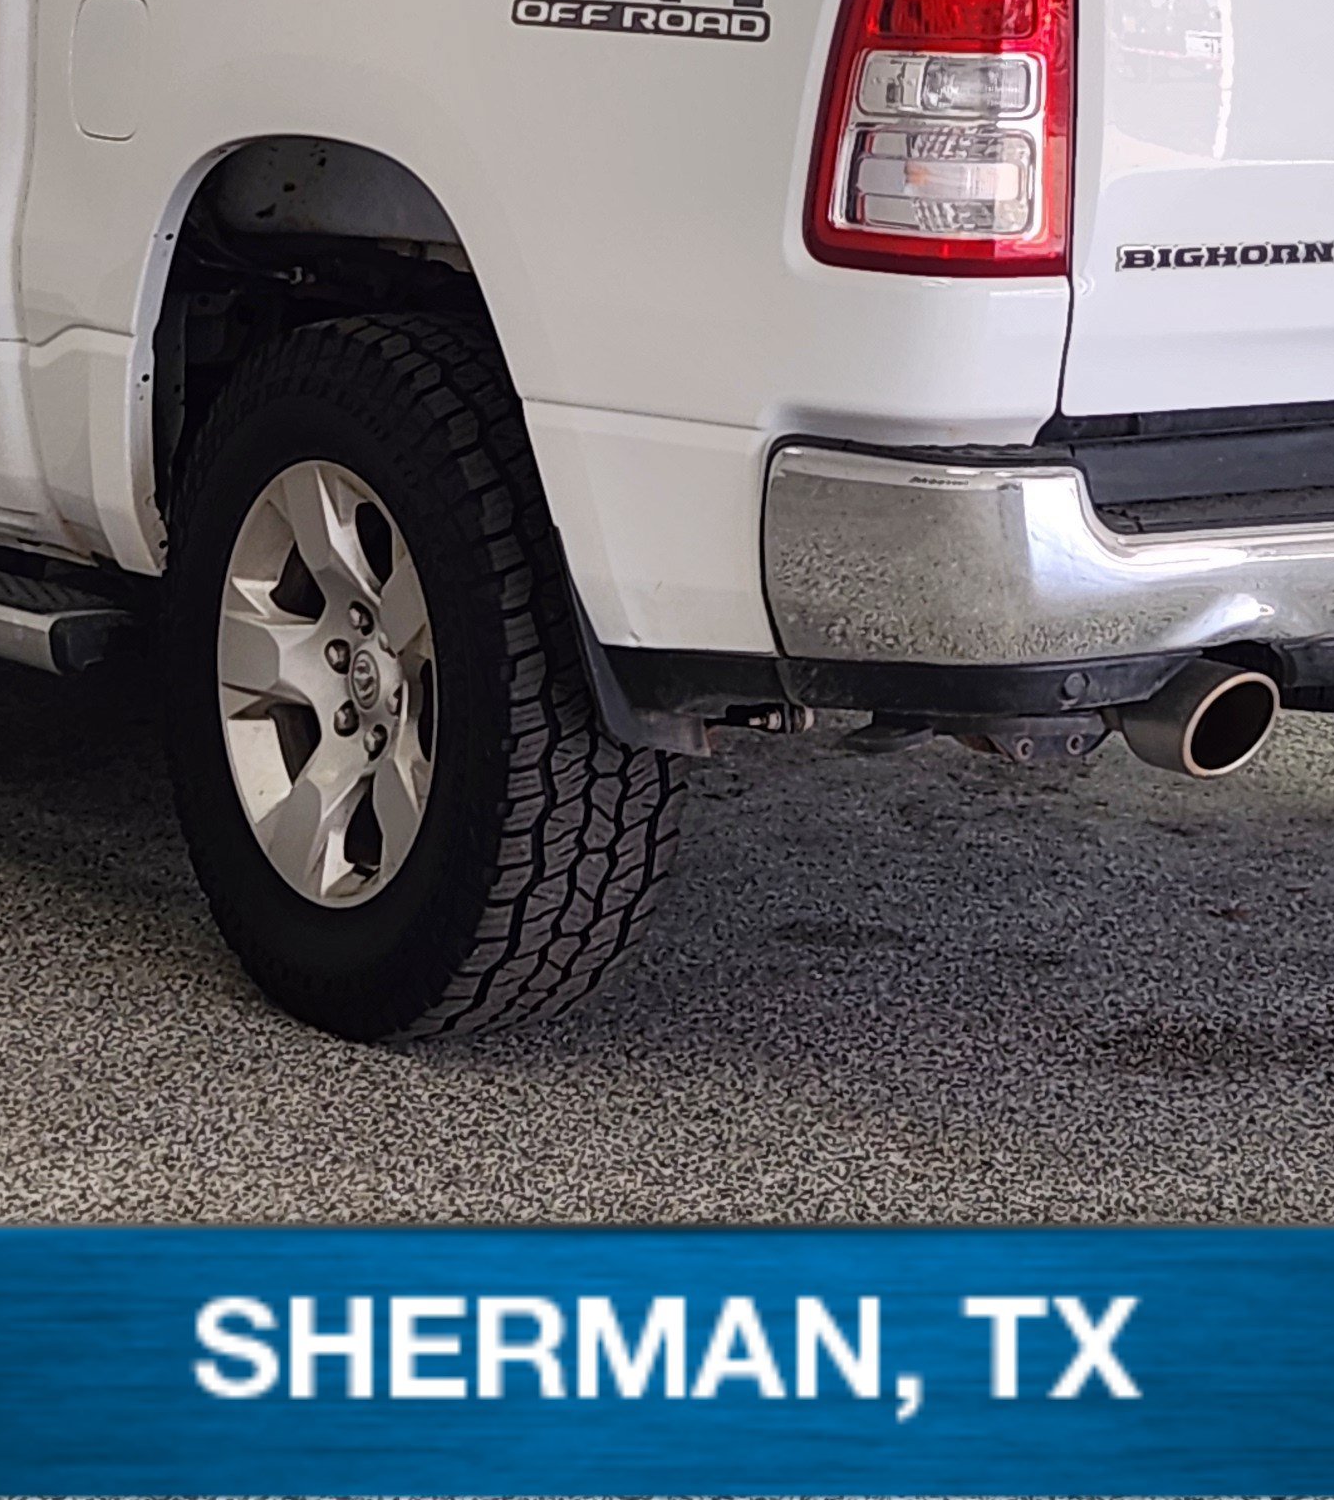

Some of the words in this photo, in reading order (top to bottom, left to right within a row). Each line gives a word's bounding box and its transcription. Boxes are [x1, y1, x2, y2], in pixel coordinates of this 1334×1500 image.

[516, 0, 614, 25] OFF
[622, 6, 766, 37] ROAD
[1116, 241, 1334, 271] BIGHORN
